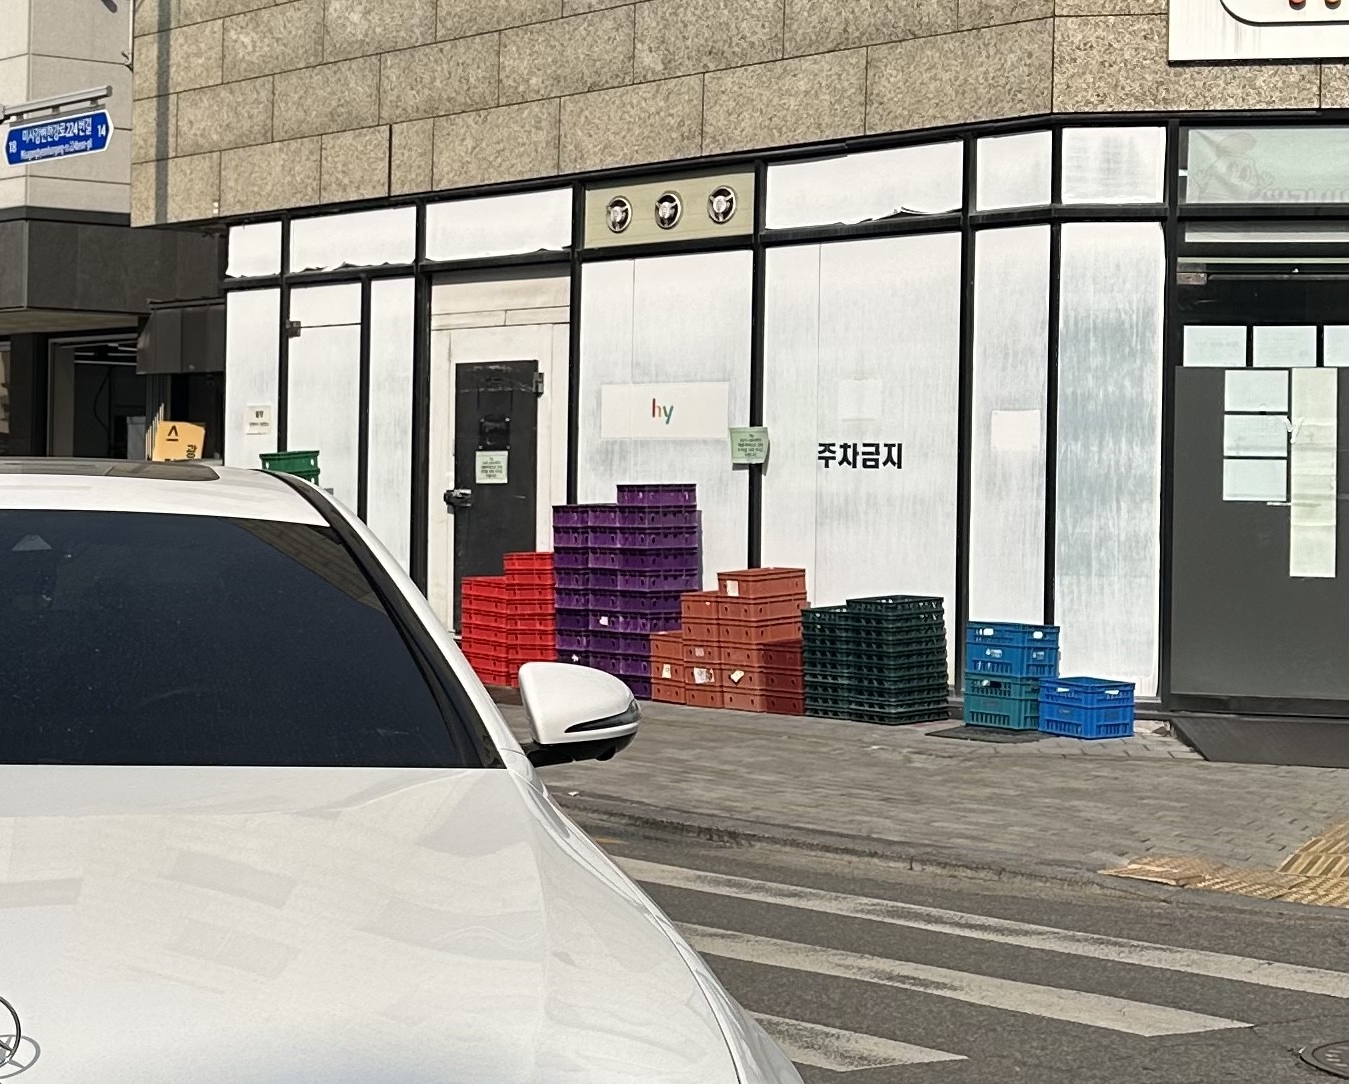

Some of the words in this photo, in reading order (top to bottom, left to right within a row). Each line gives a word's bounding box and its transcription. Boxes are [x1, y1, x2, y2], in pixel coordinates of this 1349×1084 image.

[97, 123, 106, 138] 14
[651, 398, 674, 425] hy
[817, 442, 903, 470] 주차금지
